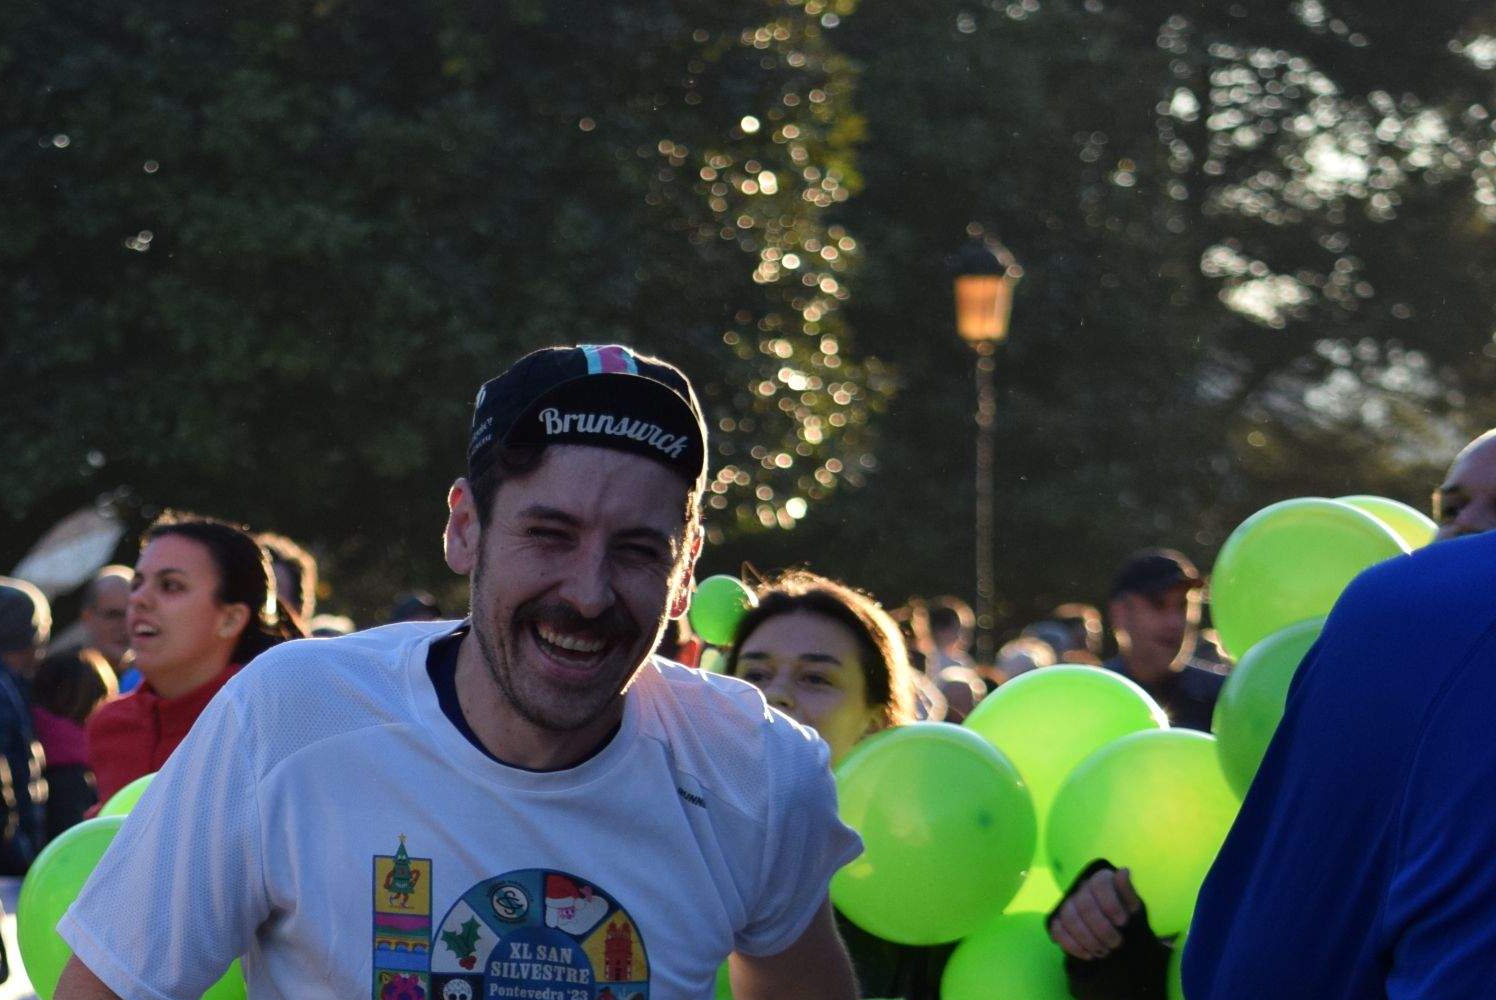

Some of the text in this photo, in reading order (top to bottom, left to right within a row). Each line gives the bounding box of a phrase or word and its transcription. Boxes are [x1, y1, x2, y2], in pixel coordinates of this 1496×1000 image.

[510, 942, 572, 964] XL SAN
[491, 961, 590, 984] SILVESTRE
[489, 983, 564, 1000] Pontevedra
